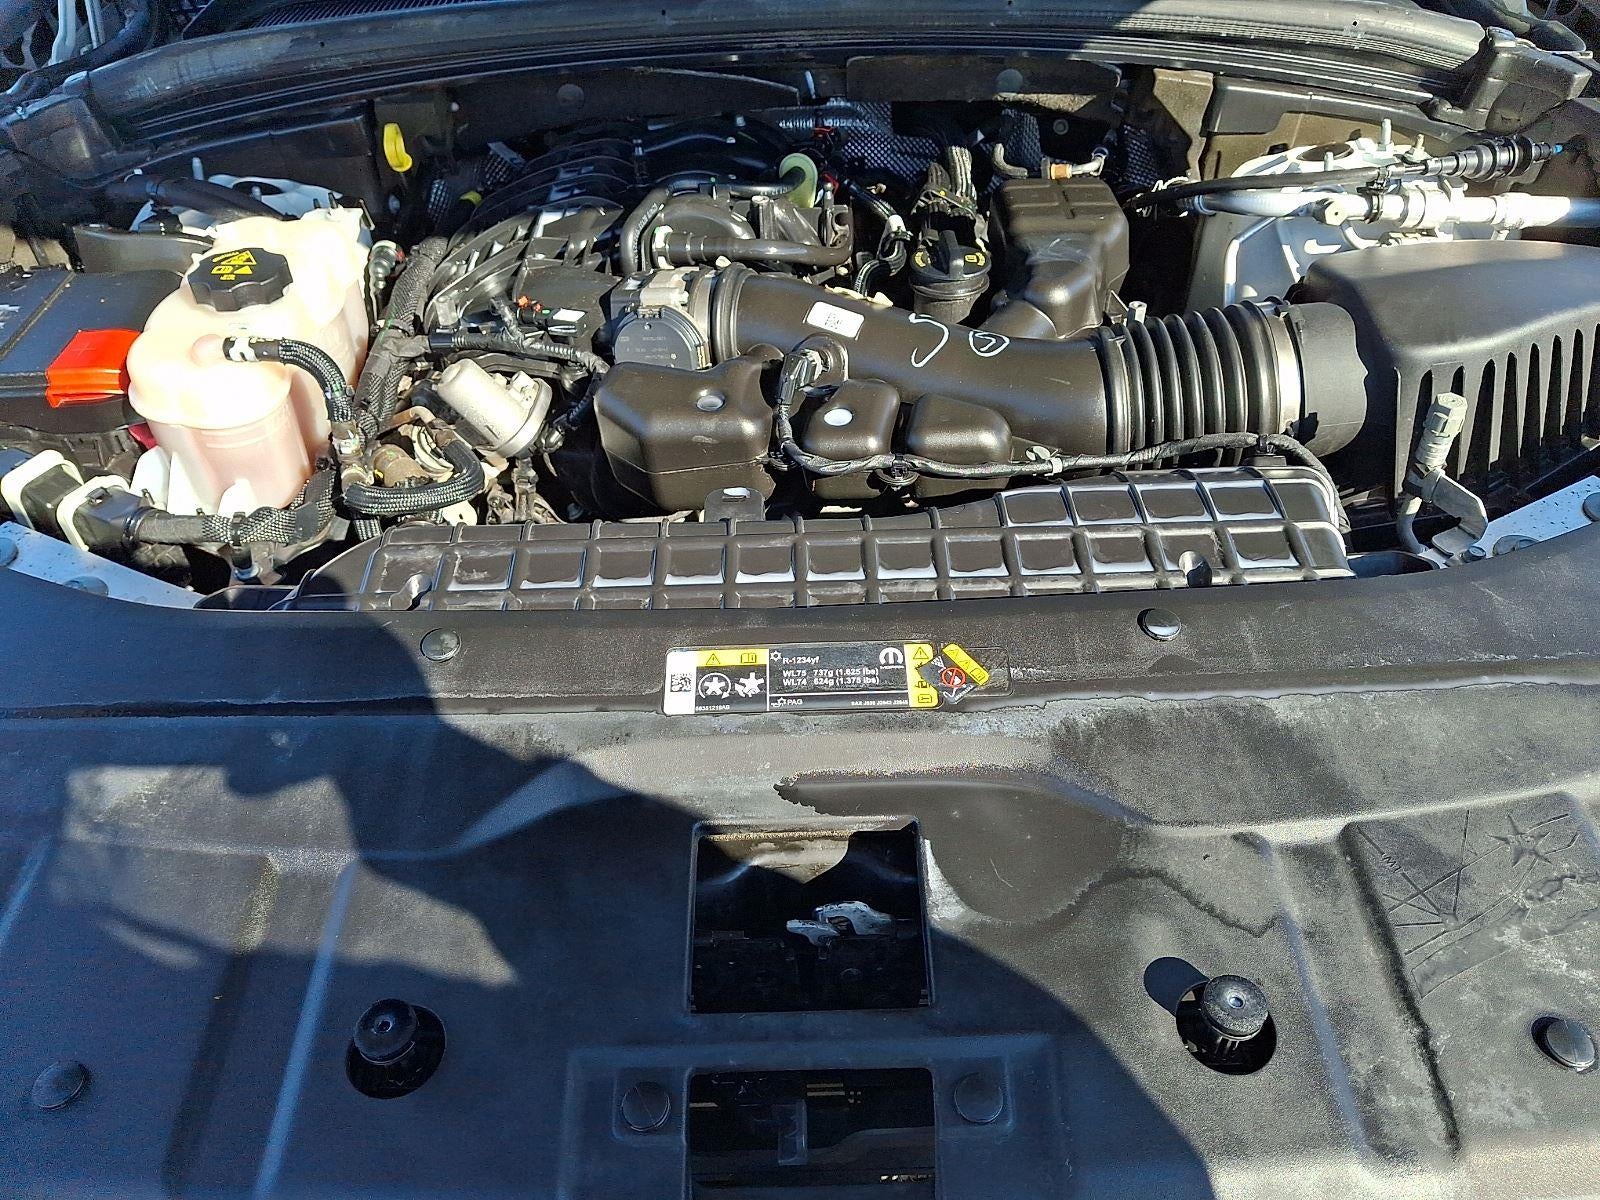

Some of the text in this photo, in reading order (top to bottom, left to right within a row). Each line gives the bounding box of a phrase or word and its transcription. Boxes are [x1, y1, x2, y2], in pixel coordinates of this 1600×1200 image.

[782, 655, 819, 665] R-1234yf
[782, 669, 807, 678] WL75
[813, 669, 834, 678] 737g
[862, 667, 879, 676] lbs)
[782, 678, 807, 686] WL74
[813, 678, 835, 686] 624g
[863, 676, 880, 685] lbs)
